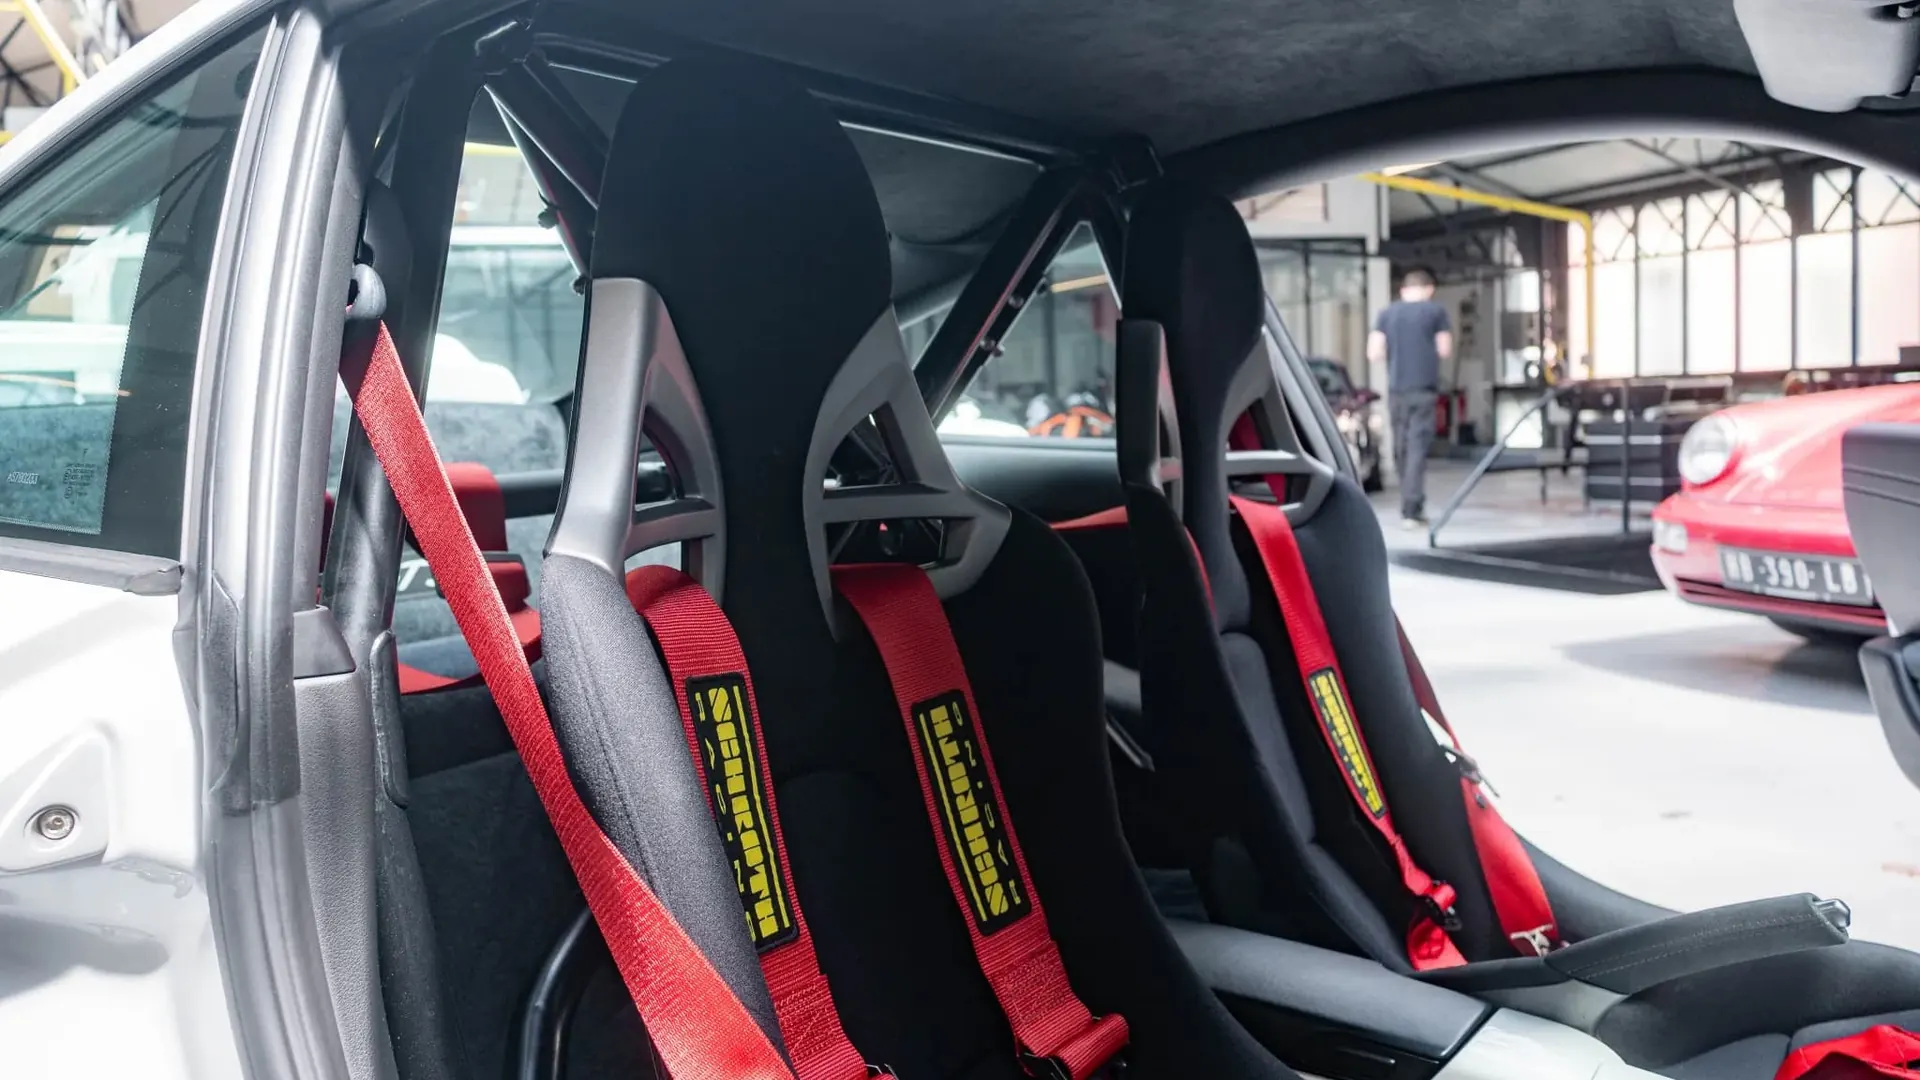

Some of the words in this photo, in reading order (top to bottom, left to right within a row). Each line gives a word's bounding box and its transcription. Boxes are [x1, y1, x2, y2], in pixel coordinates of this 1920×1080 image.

[708, 686, 779, 938] SCHROTH
[930, 705, 1009, 916] SCHROTH
[953, 701, 1022, 906] RACING
